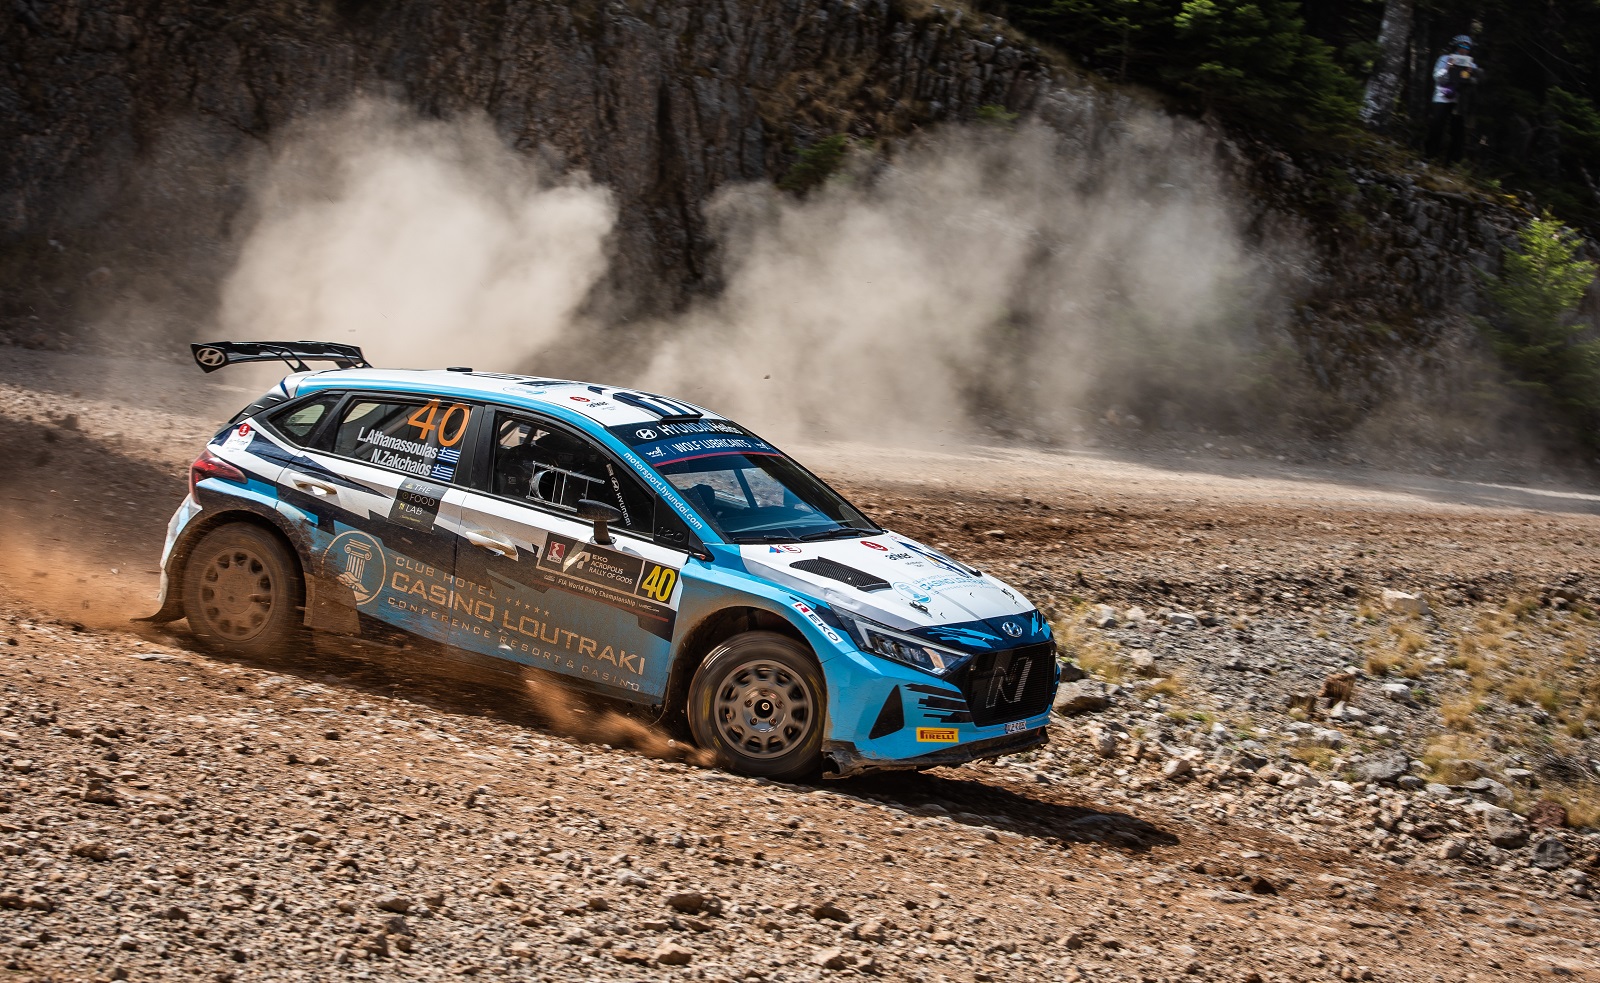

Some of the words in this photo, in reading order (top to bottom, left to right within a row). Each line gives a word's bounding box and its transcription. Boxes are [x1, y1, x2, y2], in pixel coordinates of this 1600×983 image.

[407, 398, 470, 447] 40
[656, 422, 715, 436] HYUNDAI
[357, 427, 438, 458] L.Athanassoulas
[671, 440, 702, 453] WOLF
[699, 438, 752, 449] LUBRICANTS
[370, 449, 431, 476] N.Zakchaios
[409, 493, 435, 507] FOOD
[414, 483, 432, 494] THE
[623, 452, 703, 530] motorsport.hyundai.com
[405, 504, 424, 516] LAB
[616, 492, 632, 527] HYUNDAI
[590, 561, 624, 575] ACROPOLIS
[592, 554, 608, 563] EKO
[396, 557, 435, 577] CLUB
[443, 572, 497, 600] HOTEL
[588, 566, 606, 578] RALLY
[606, 572, 616, 581] OF
[615, 575, 633, 585] GODS
[641, 566, 675, 601] 40
[557, 578, 567, 587] FIA
[567, 581, 584, 591] World
[585, 585, 598, 596] Rally
[598, 590, 636, 607] Championship
[391, 571, 496, 623] CASINO
[502, 609, 646, 676] LOUTRAKI
[808, 613, 839, 641] EKO
[388, 597, 491, 639] CONFERENCE
[499, 636, 561, 664] RESORT
[566, 660, 574, 669] &
[581, 665, 640, 692] CASINO
[919, 730, 955, 740] PIRELLI
